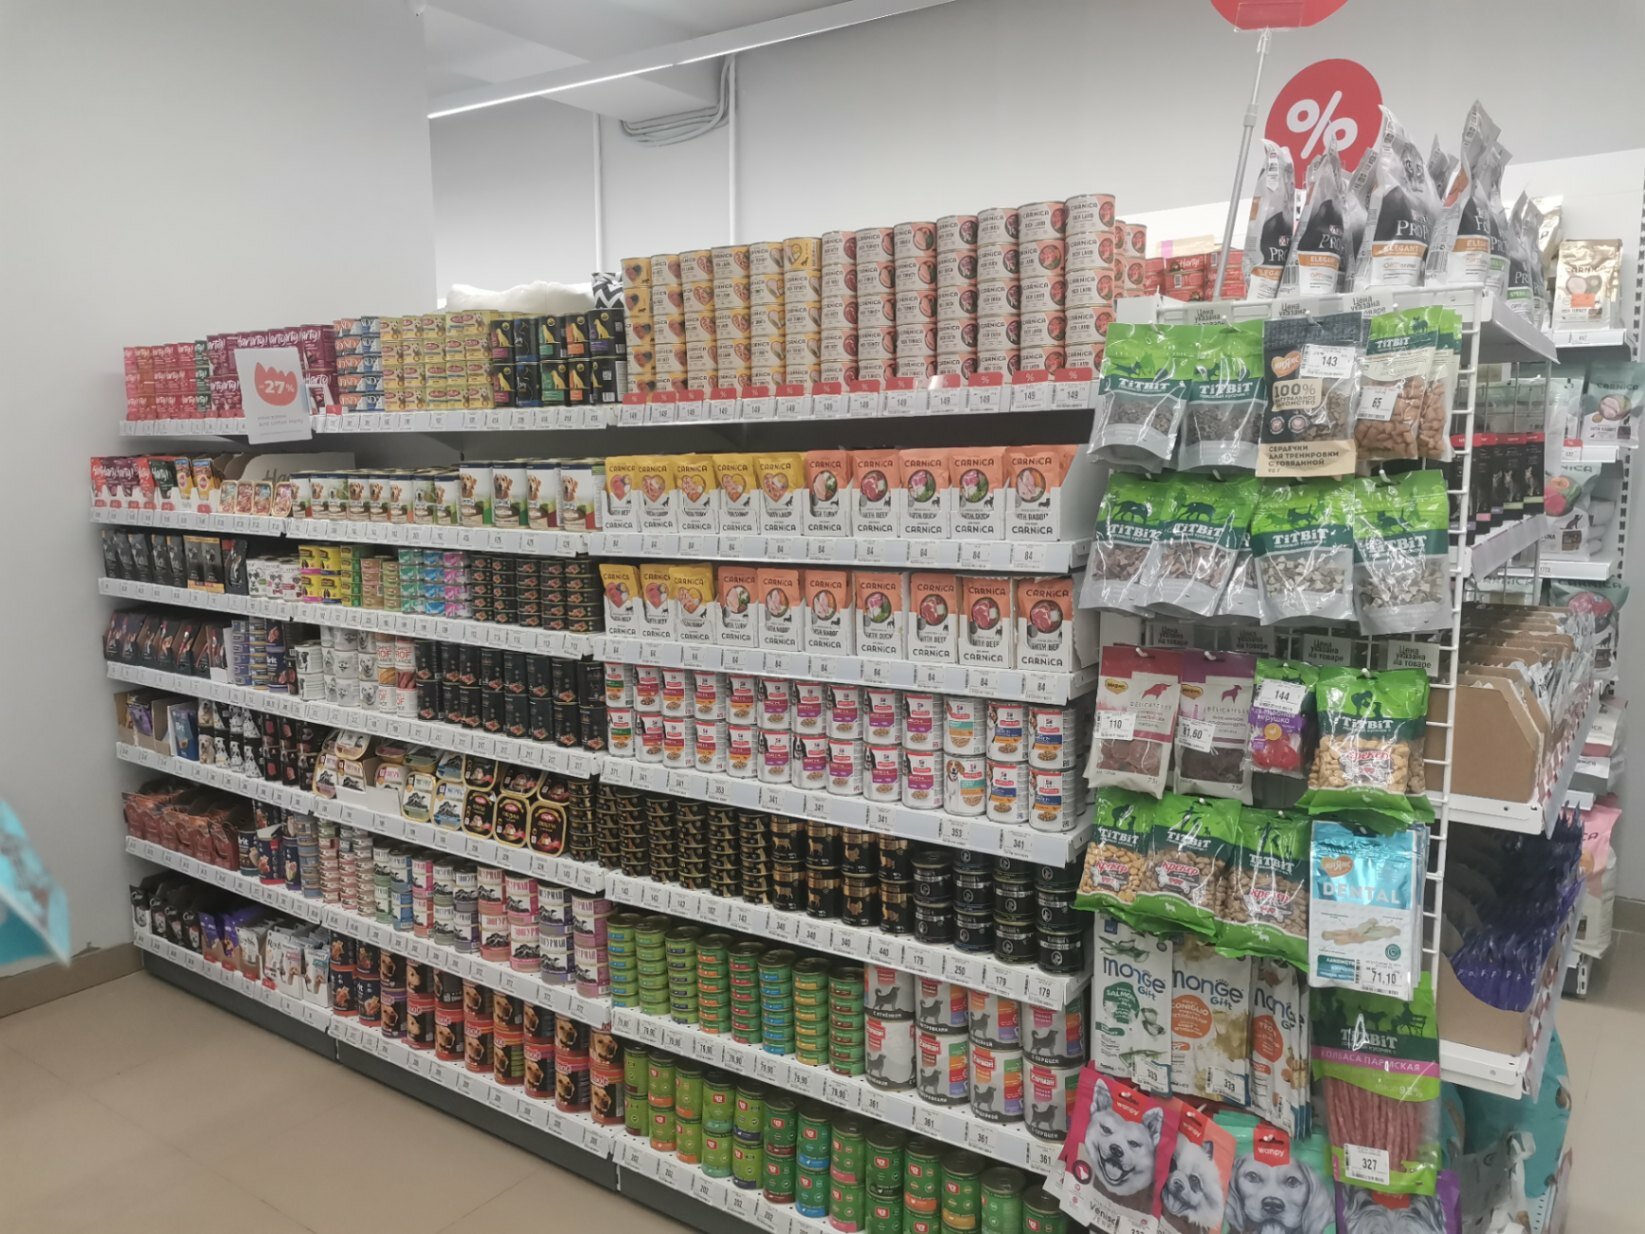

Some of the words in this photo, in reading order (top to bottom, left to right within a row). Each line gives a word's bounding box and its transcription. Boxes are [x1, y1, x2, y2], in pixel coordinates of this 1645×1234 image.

[1286, 90, 1358, 160] %
[1322, 356, 1338, 367] 143
[1067, 391, 1079, 399] 149
[1024, 551, 1033, 560] 84
[1314, 640, 1332, 649] Цена
[1311, 646, 1339, 654] указана
[1400, 645, 1419, 655] Цена
[1318, 654, 1344, 662] товаре
[1396, 652, 1426, 661] указана
[1275, 690, 1290, 701] 144
[1109, 719, 1122, 729] 110
[951, 828, 962, 838] 353
[1013, 839, 1024, 849] 341
[1323, 882, 1402, 904] DENTAL
[954, 967, 965, 976] 250
[996, 977, 1007, 986] 179
[1371, 970, 1397, 985] 71.10
[1038, 987, 1050, 998] 179
[1138, 986, 1156, 1000] Gift
[1210, 997, 1233, 1010] Gift
[1147, 1069, 1158, 1081] 333
[1224, 1080, 1235, 1092] 333
[924, 1117, 934, 1127] 361
[977, 1133, 988, 1144] 361
[1257, 1146, 1285, 1158] wanpy
[1040, 1154, 1051, 1164] 361
[1362, 1158, 1377, 1170] 327
